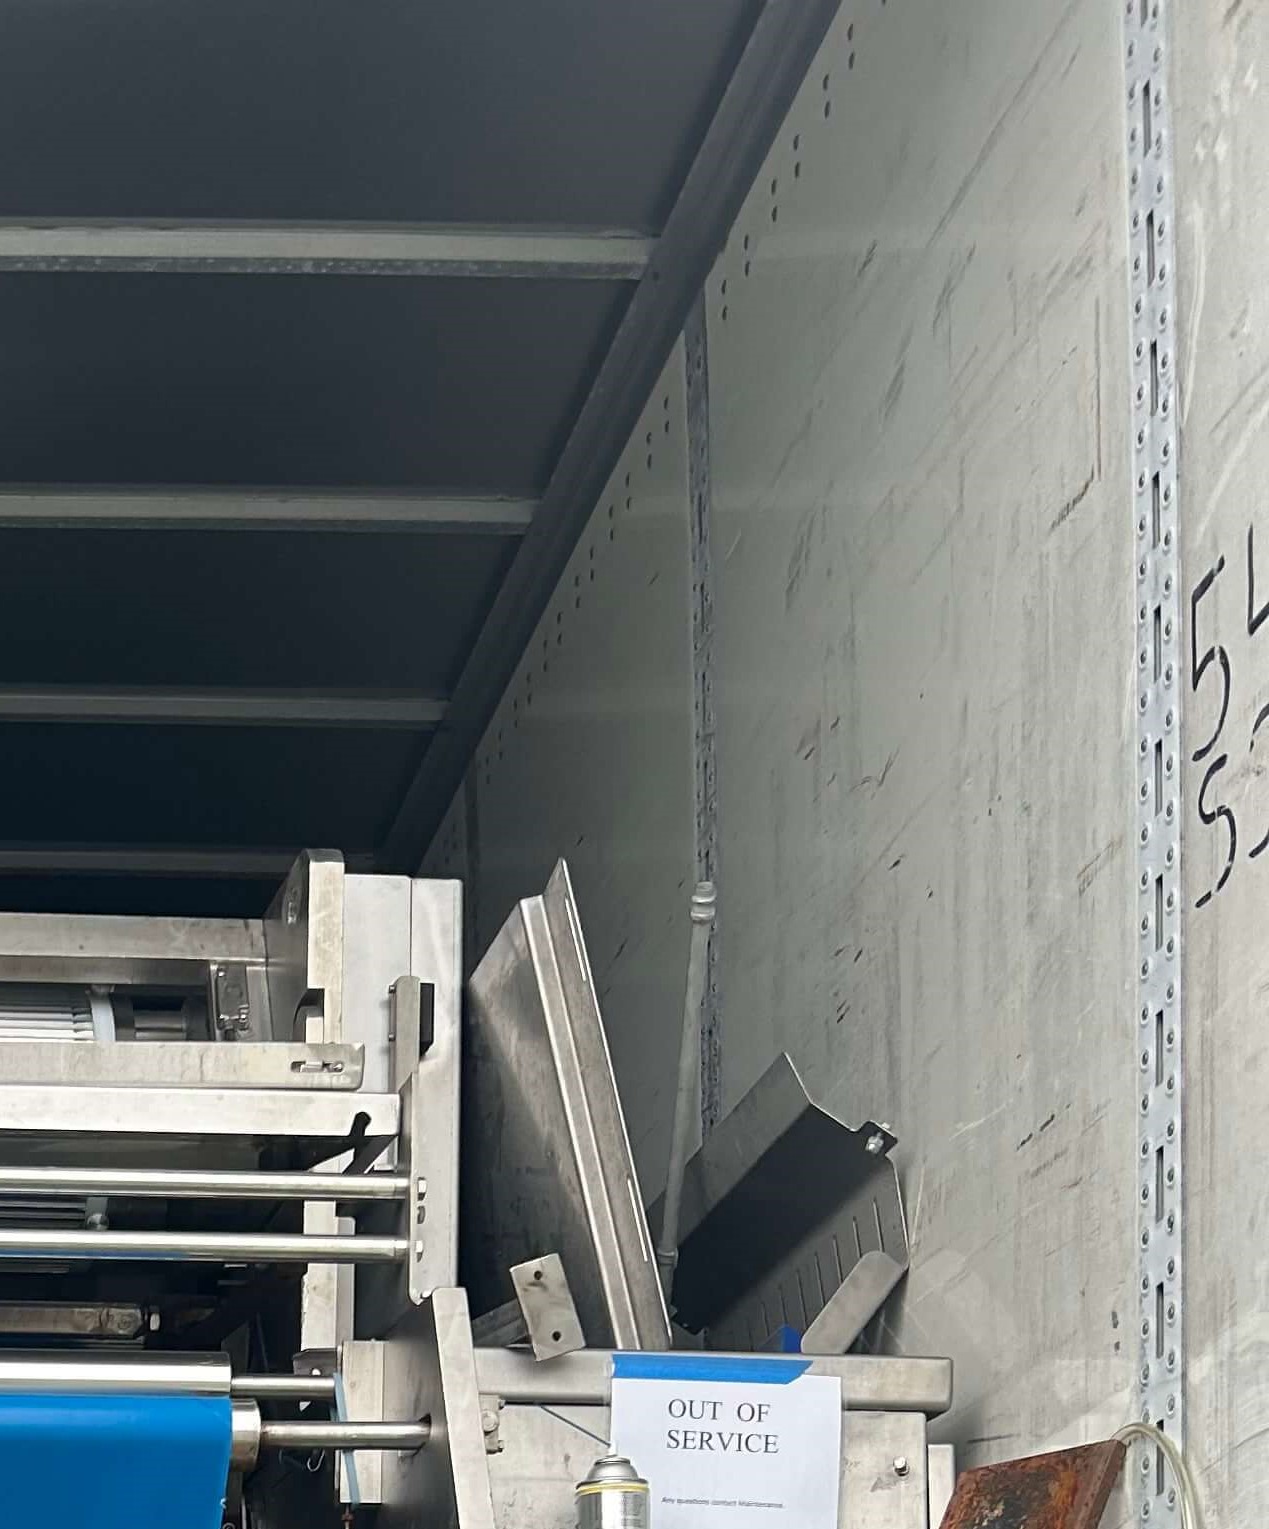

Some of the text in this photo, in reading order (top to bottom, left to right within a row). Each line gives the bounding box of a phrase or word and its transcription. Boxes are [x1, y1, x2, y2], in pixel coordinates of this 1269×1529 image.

[668, 1398, 772, 1423] OUT OF
[666, 1429, 780, 1454] SERVICE
